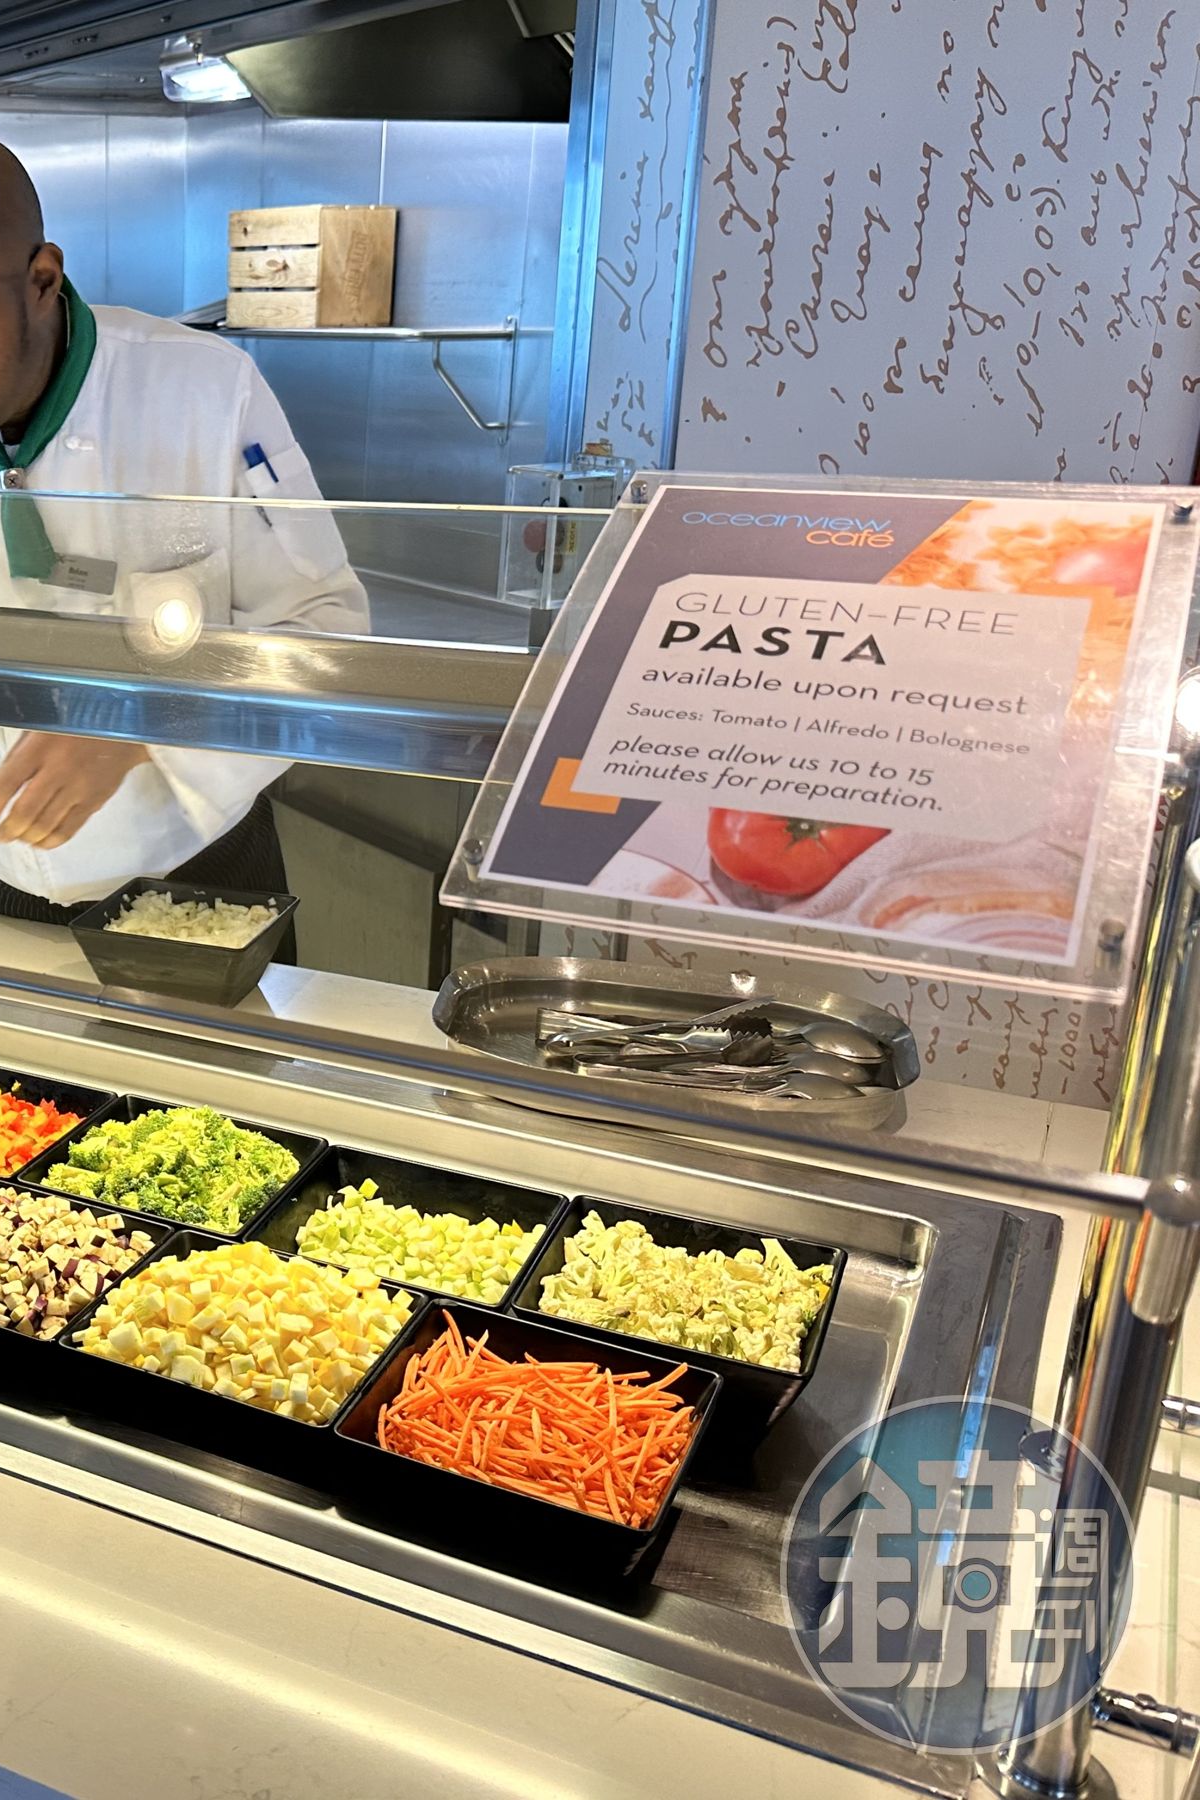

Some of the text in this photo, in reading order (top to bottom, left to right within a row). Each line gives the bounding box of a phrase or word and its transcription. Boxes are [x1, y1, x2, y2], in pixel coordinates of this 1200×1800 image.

[682, 511, 891, 532] oceanview
[806, 528, 894, 548] café
[676, 592, 1019, 636] GLUTEN-FREE
[659, 620, 887, 665] PASTA
[642, 666, 1028, 715] available upon request
[627, 702, 703, 722] Sauces:
[712, 709, 787, 730] Tomato
[806, 718, 889, 740] Alfredo
[910, 729, 1031, 755] Bolognese
[609, 735, 935, 786] please allow us 10 to 15
[603, 759, 943, 811] minutes for preparation.
